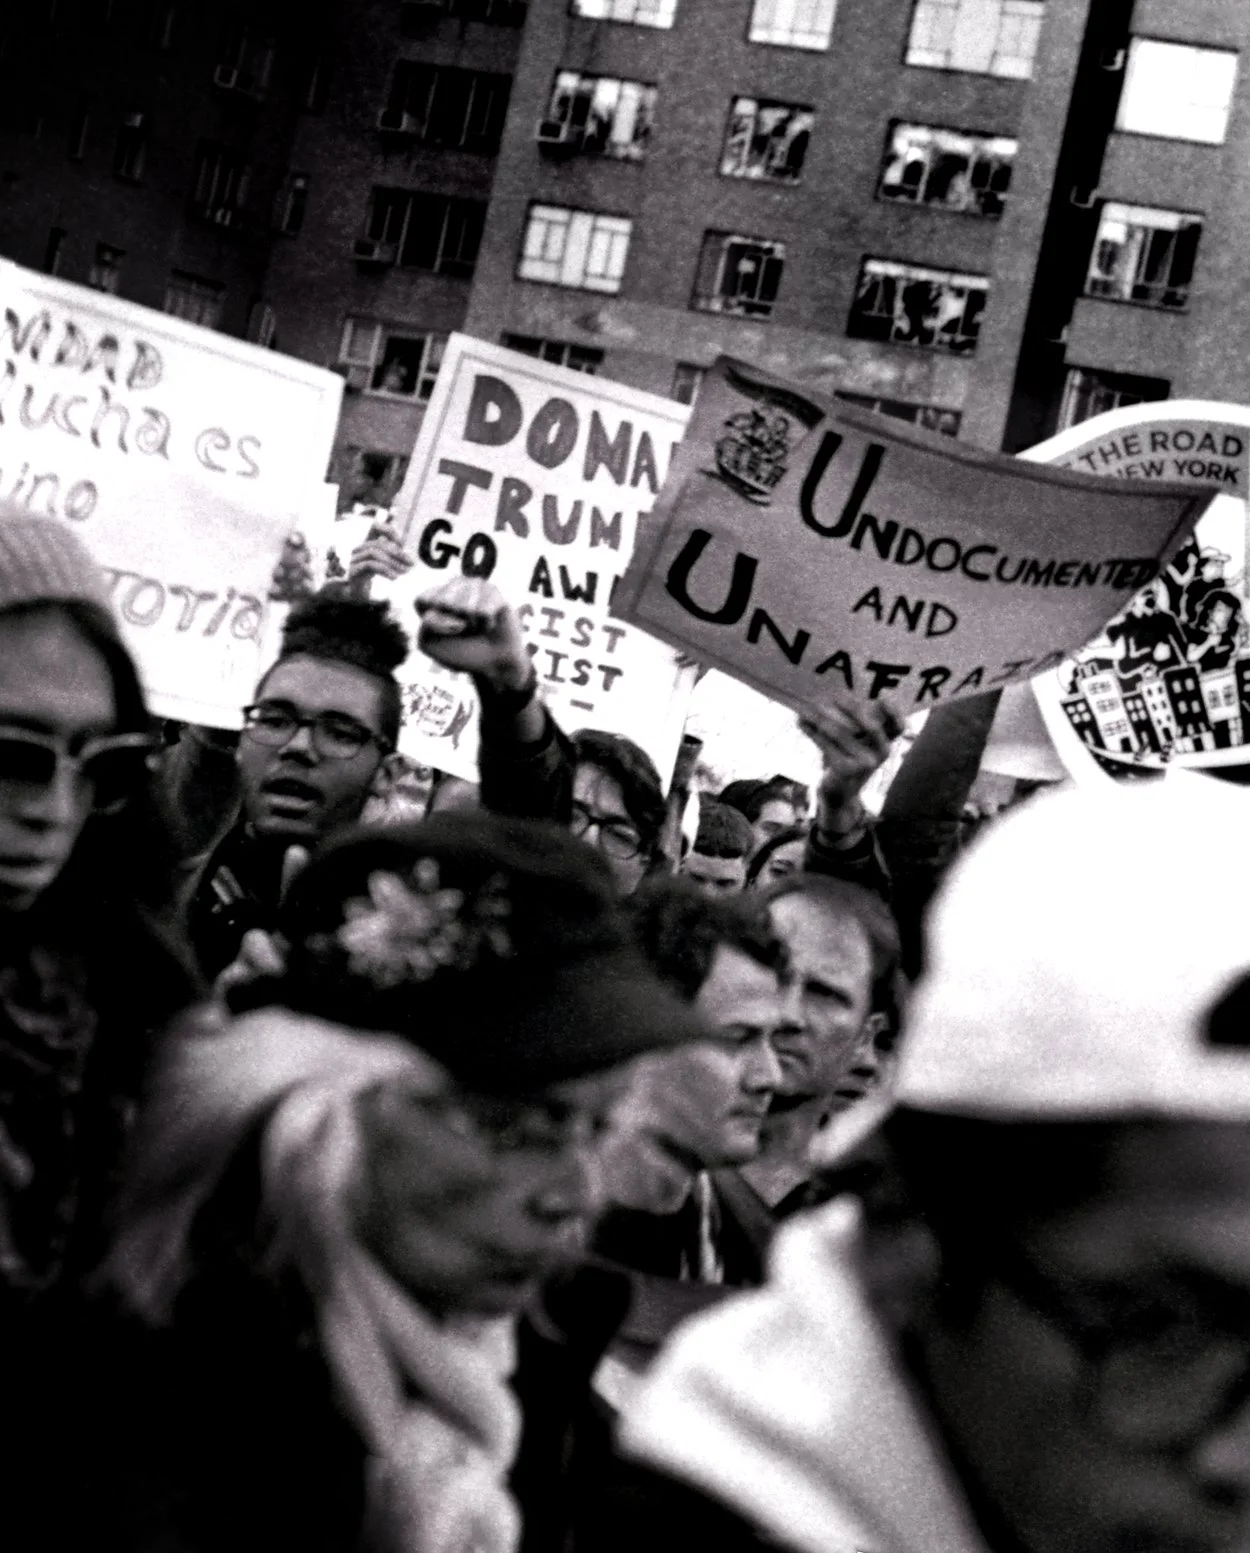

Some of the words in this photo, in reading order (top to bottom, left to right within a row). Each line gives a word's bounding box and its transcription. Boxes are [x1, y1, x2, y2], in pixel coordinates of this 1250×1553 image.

[194, 427, 262, 479] es
[462, 373, 679, 495] DONA
[1078, 432, 1143, 472] THE
[1150, 430, 1244, 458] ROAD
[0, 461, 99, 523] ino
[1174, 458, 1240, 485] YORK
[438, 457, 642, 551] TRUM
[418, 518, 498, 581] GO
[528, 553, 617, 607] AW
[852, 585, 959, 639] AND
[525, 641, 624, 692] IST
